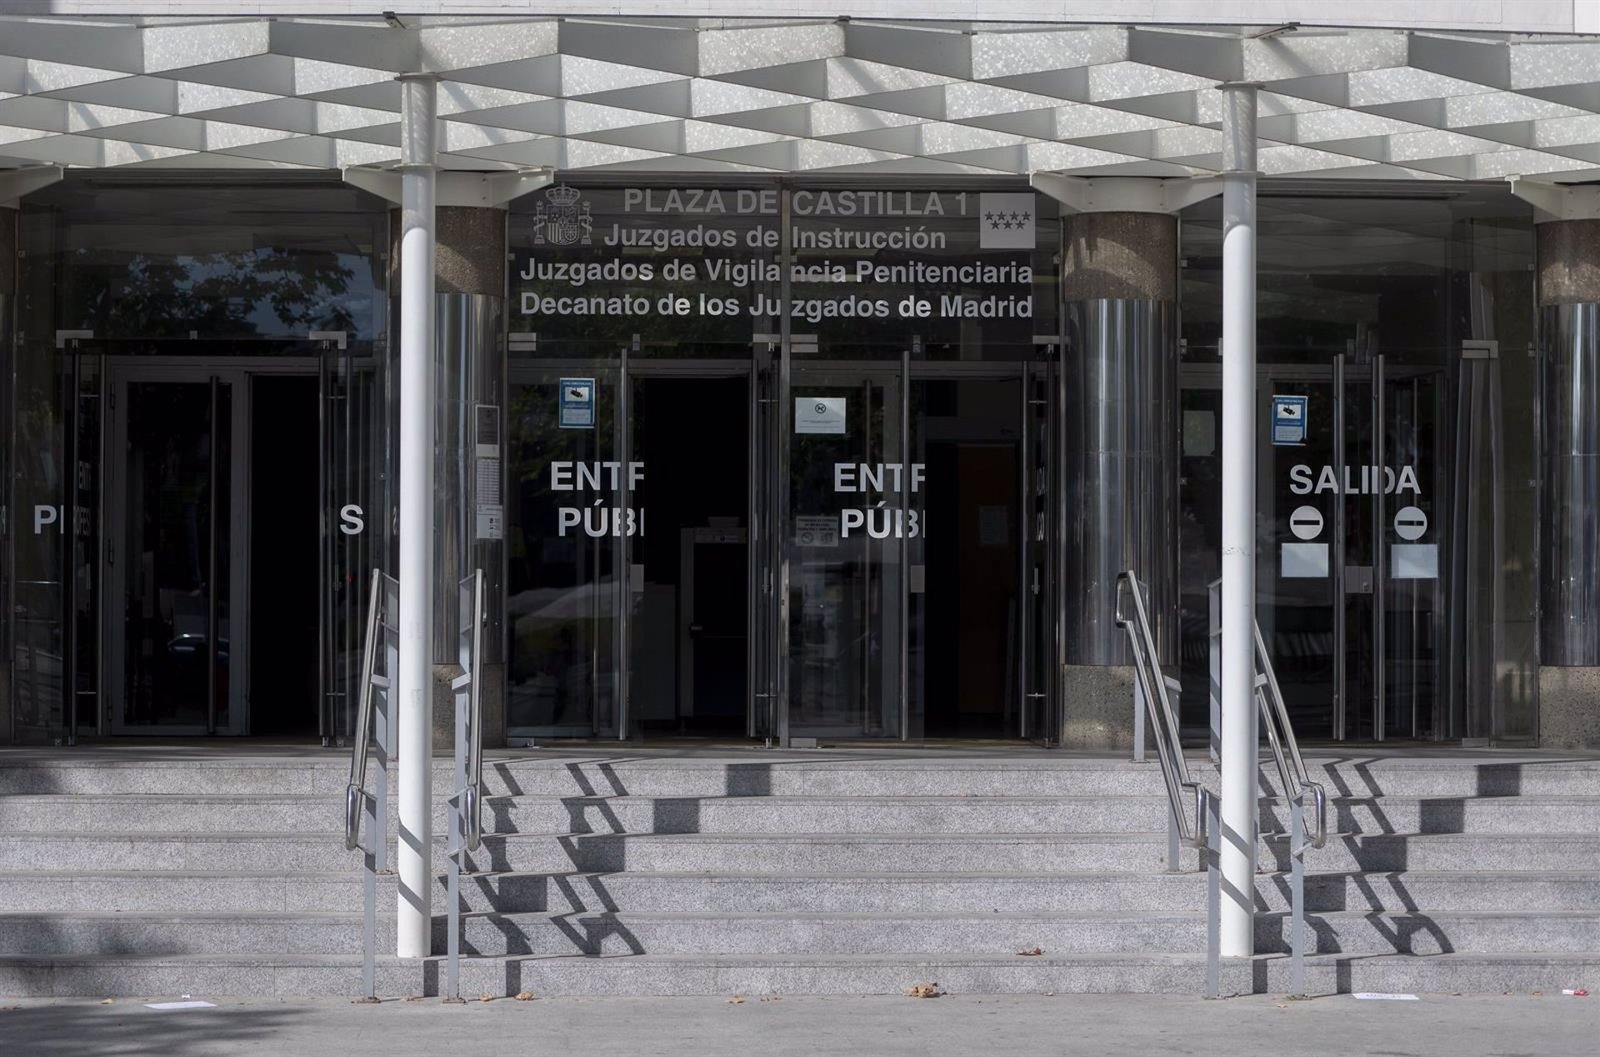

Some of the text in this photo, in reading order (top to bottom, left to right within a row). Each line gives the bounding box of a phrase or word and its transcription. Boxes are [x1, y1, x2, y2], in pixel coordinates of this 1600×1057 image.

[624, 189, 967, 216] PLAZA DE CASTILLA 1
[603, 223, 947, 252] Juzgados de Instrucción
[519, 257, 1034, 288] Juzgados de Vigilancia Penitenciaria
[520, 291, 1034, 324] Decanato de los Juzgados de Madrid
[1289, 464, 1422, 495] SALIDA
[558, 498, 645, 537] PÚB
[841, 500, 926, 539] PÚB
